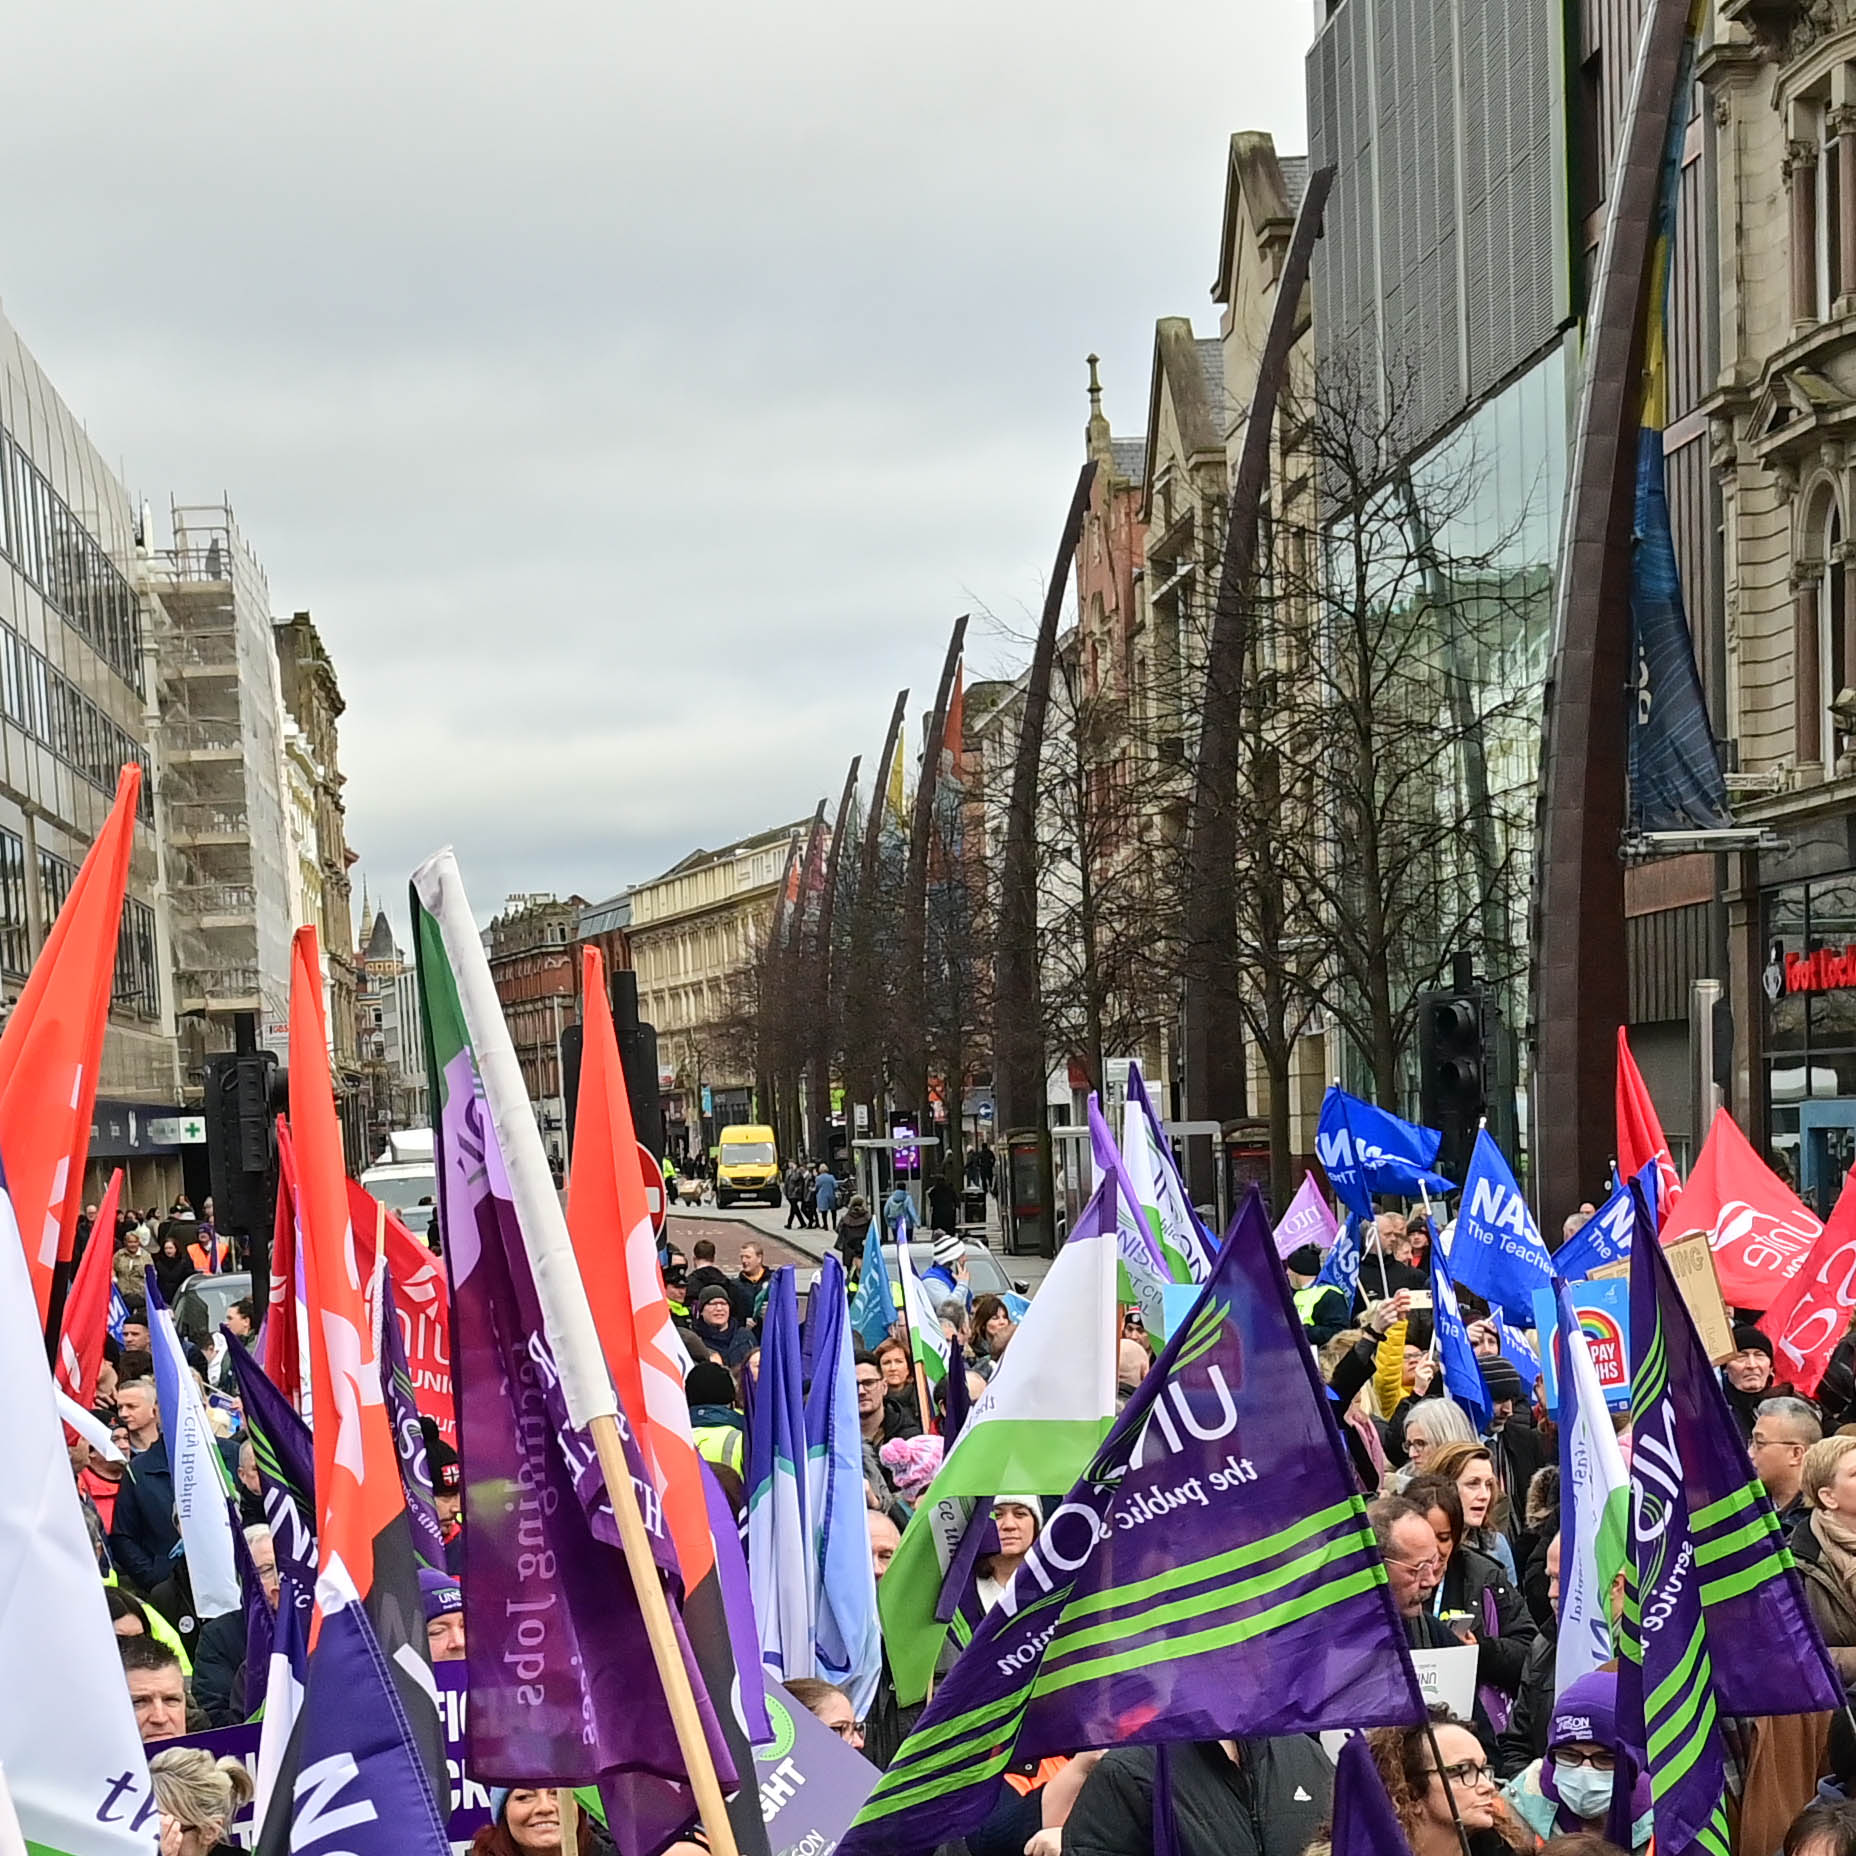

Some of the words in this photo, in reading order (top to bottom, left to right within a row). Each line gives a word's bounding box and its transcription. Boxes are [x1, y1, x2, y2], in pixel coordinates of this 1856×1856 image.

[1785, 951, 1821, 992] Foot
[1467, 1218, 1495, 1247] The
[1587, 1227, 1612, 1259] The
[1591, 1342, 1616, 1362] PAY
[95, 1769, 163, 1841] th
